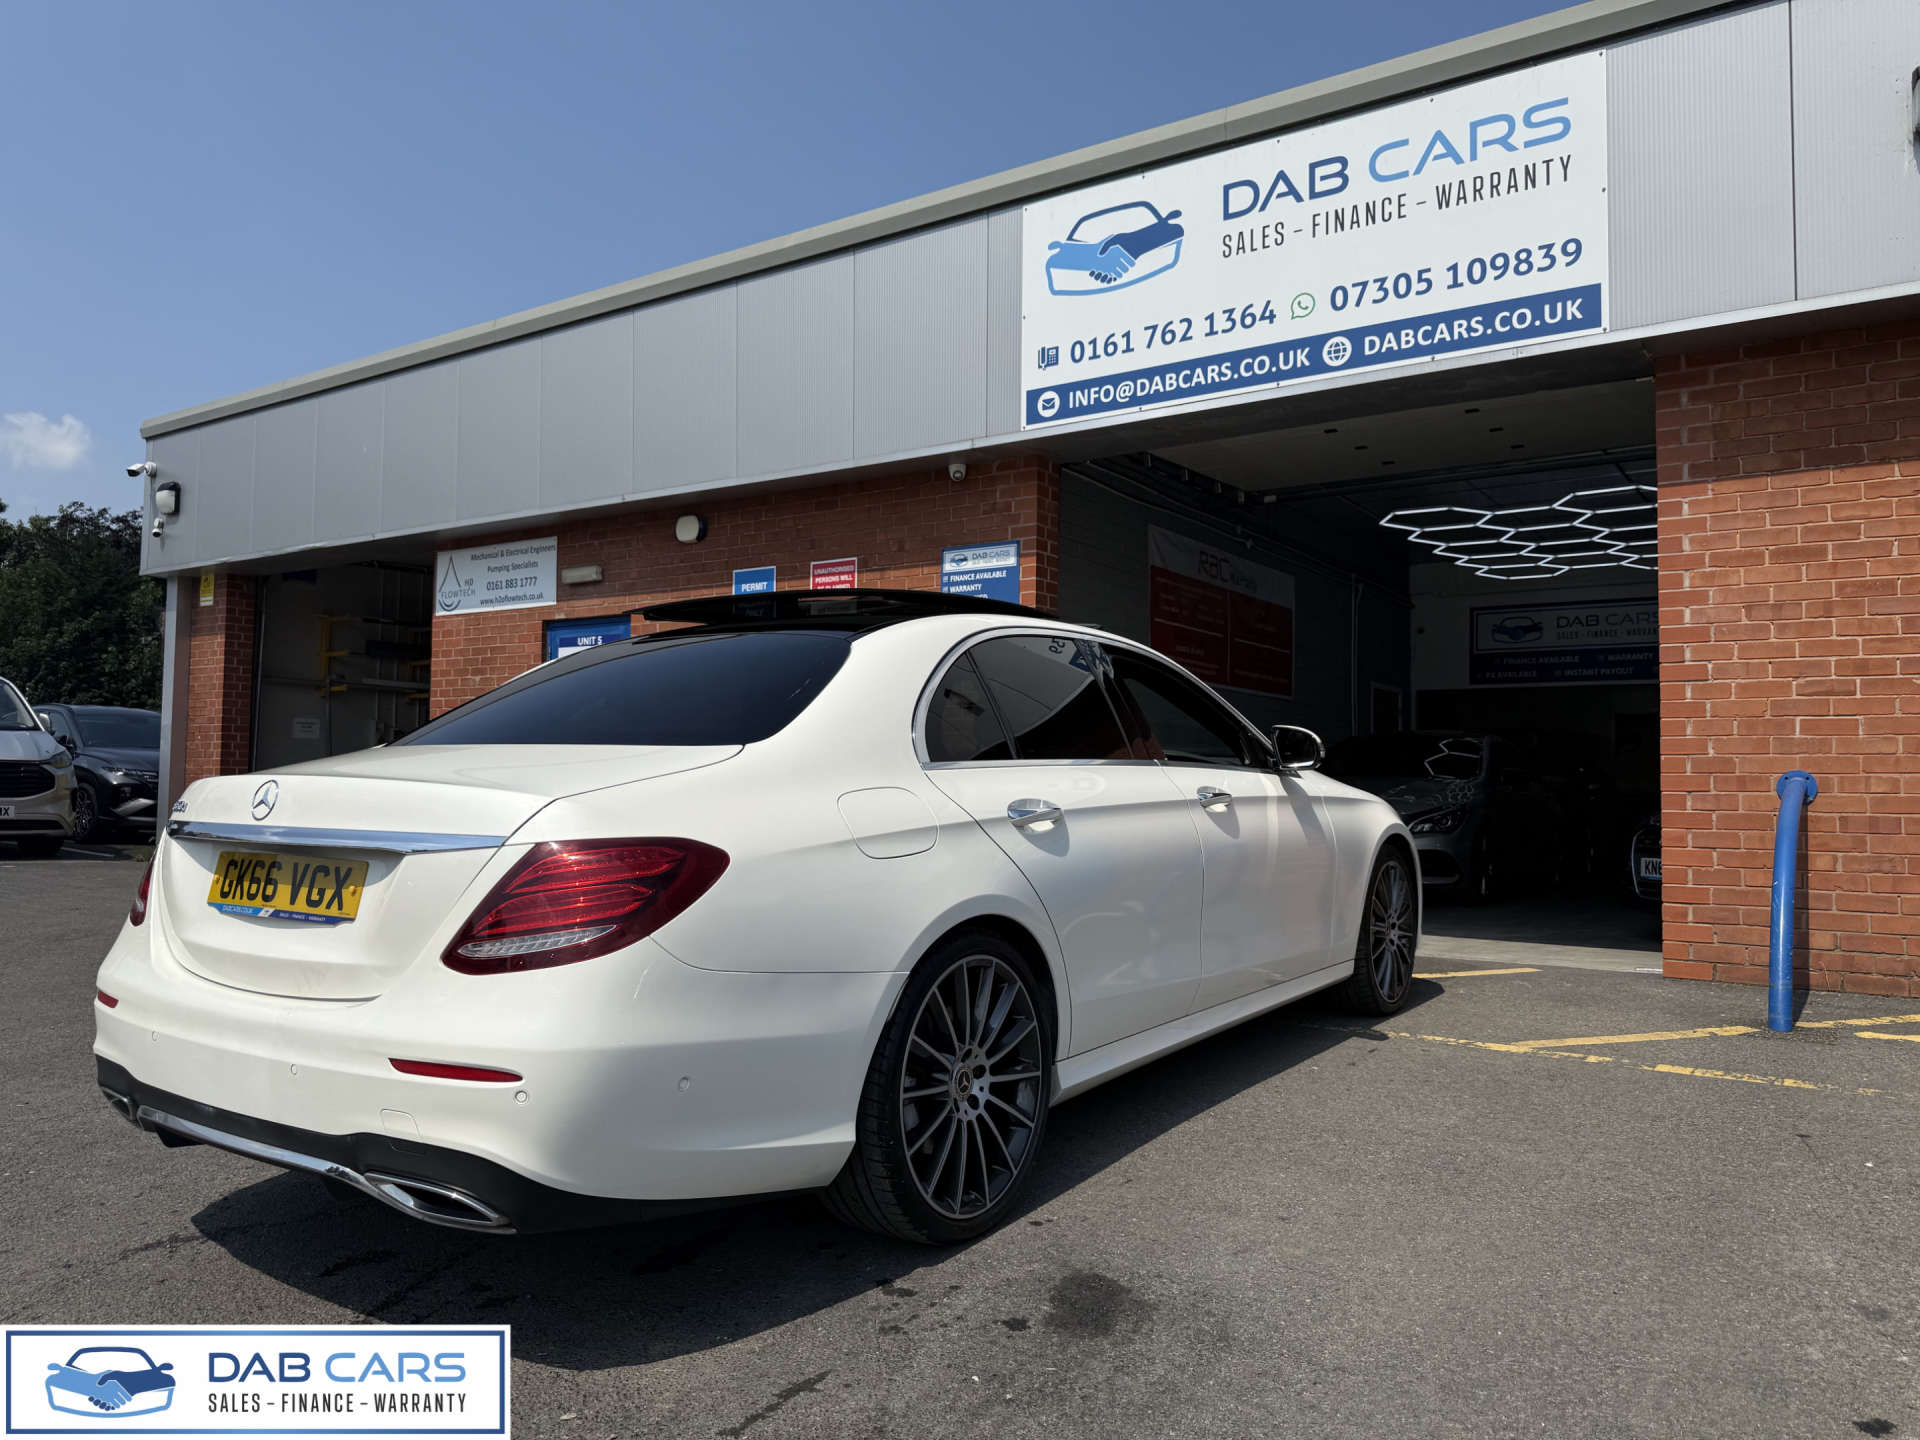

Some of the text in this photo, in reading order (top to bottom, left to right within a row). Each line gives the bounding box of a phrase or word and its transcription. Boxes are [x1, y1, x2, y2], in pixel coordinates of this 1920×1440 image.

[1222, 96, 1572, 221] DAB CARS
[1222, 222, 1286, 259] SALES
[1312, 194, 1408, 238] FINANCE
[1436, 154, 1572, 210] WARRANTY
[1329, 237, 1584, 313] 07305 109839
[1070, 300, 1277, 364] 0161 762 1364
[1363, 297, 1584, 356] DABCARS.CO.UK
[1068, 345, 1311, 409] INFO@DABCARS.CO.UK
[530, 544, 556, 555] Engineers
[972, 552, 988, 560] DAB
[487, 560, 539, 573] Pumping Specialists
[486, 581, 503, 591] 0161
[519, 576, 538, 587] 1777
[950, 570, 1008, 582] FINANCE AVAILABLE
[441, 588, 476, 599] FLOWTECH
[741, 582, 768, 592] PERMIT
[950, 583, 982, 593] WARRANTY
[1556, 614, 1600, 629] DAB
[577, 635, 603, 646] UNIT 5
[219, 859, 353, 912] GK66 VGX
